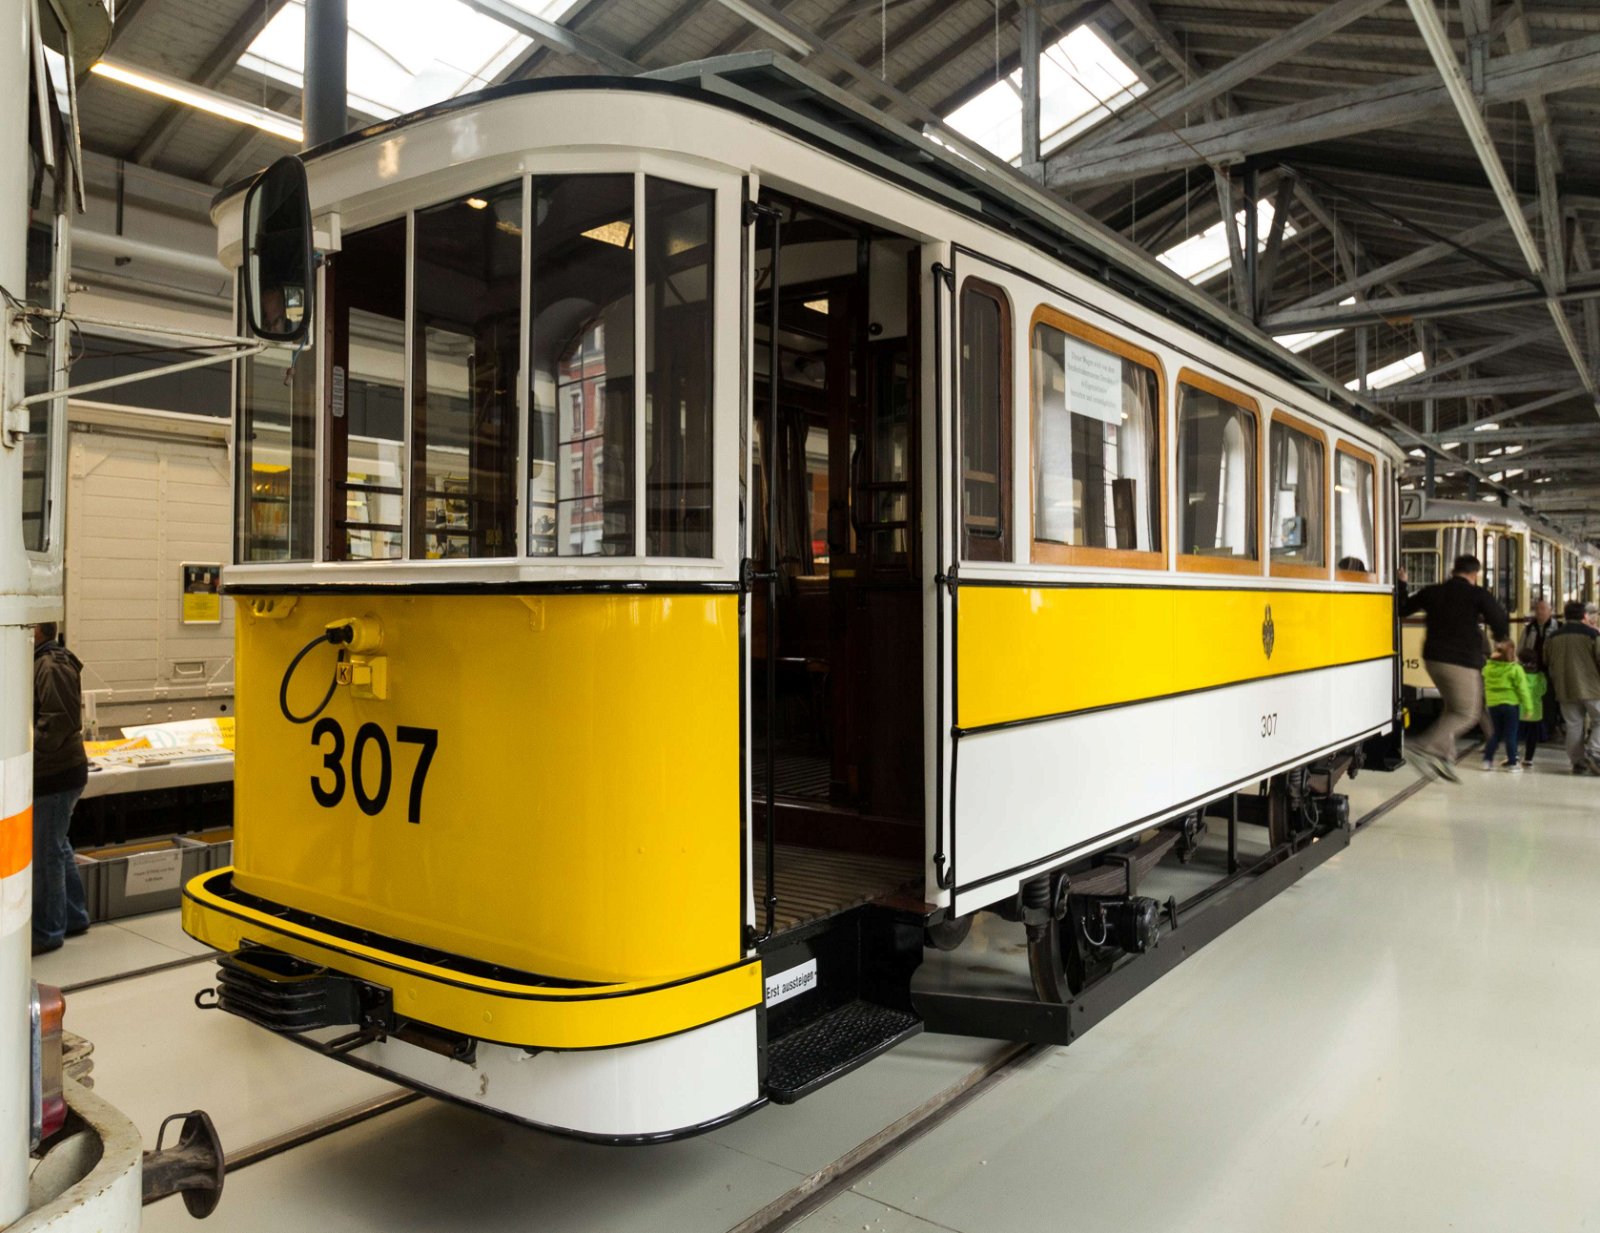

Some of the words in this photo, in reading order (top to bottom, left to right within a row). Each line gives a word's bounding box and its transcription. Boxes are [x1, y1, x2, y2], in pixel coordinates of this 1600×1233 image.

[340, 667, 347, 681] K
[1403, 658, 1419, 669] 15
[1261, 713, 1277, 738] 307
[311, 717, 438, 824] 307
[766, 984, 779, 999] Erst
[782, 971, 814, 993] aussteigen
